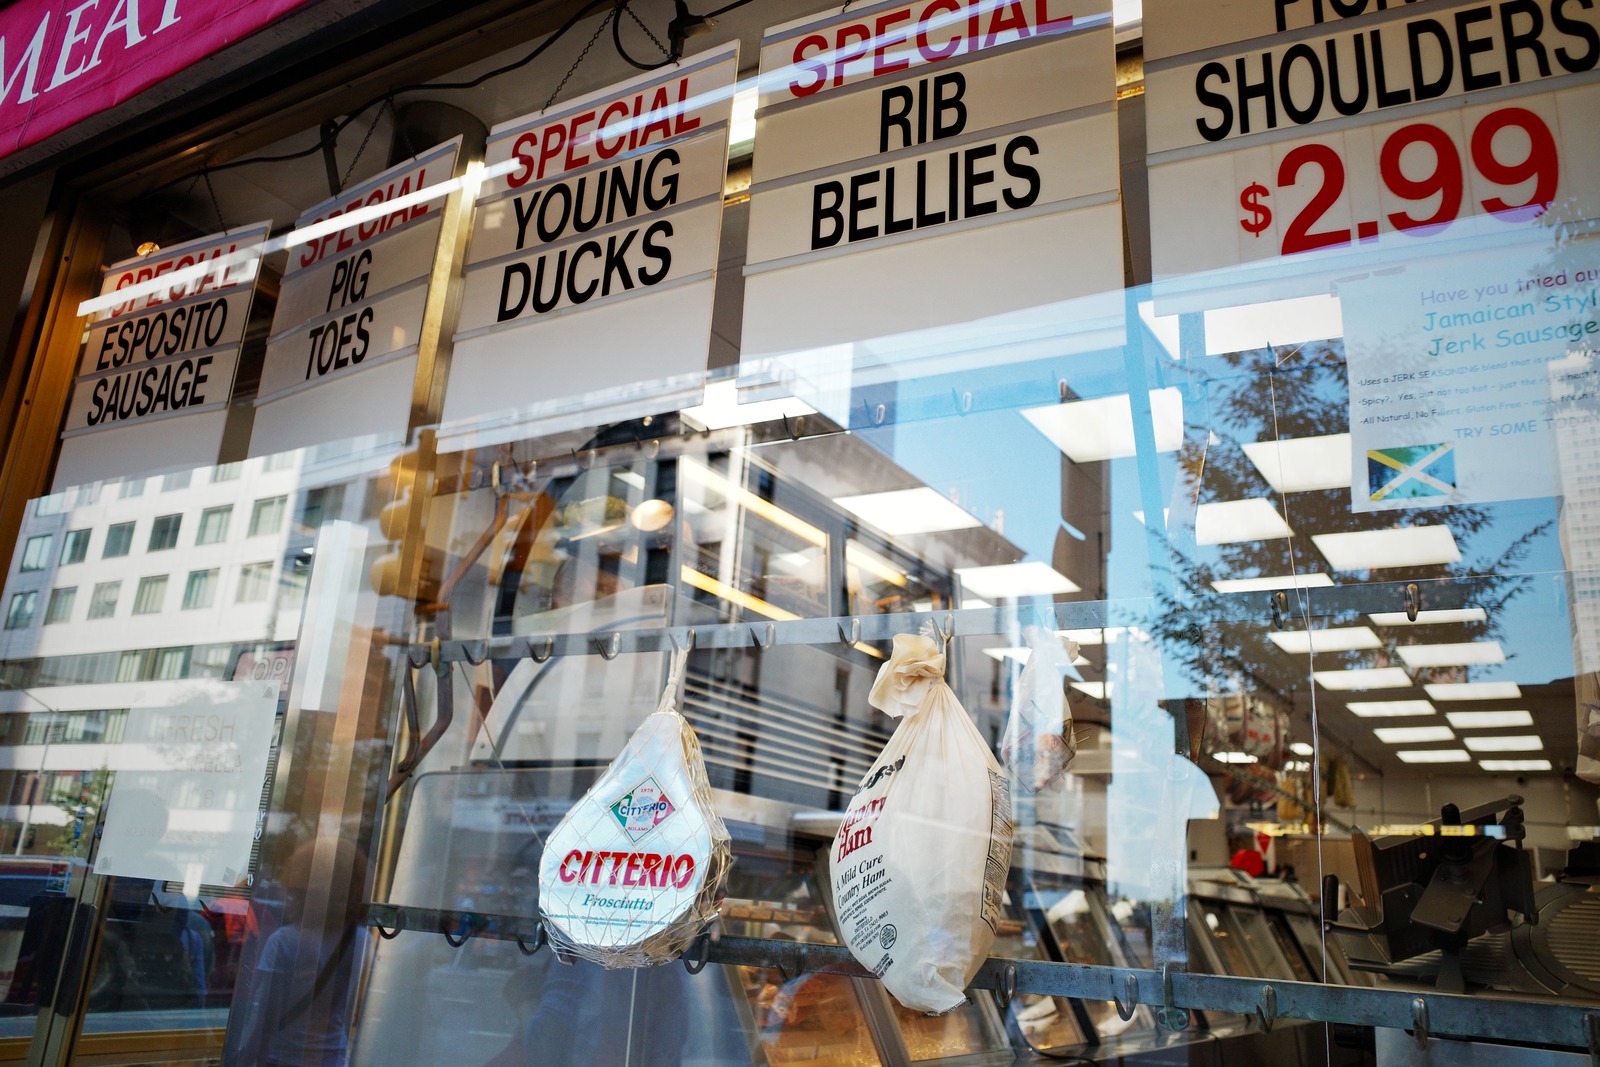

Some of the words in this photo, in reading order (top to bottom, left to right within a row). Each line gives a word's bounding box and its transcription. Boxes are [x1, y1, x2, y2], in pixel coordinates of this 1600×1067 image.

[789, 0, 1074, 98] SPECIAL
[1195, 0, 1600, 142] SHOULDERS
[506, 78, 701, 189] SPECIAL
[880, 71, 967, 154] RIB
[513, 148, 681, 251] YOUNG
[811, 135, 1041, 251] BELLIES
[1240, 107, 1559, 256] $2.99
[301, 169, 429, 268] SPECIAL
[327, 248, 372, 313] PIG
[497, 220, 674, 323] DUCKS
[1420, 290, 1469, 306] Have
[1475, 284, 1509, 302] you
[1516, 269, 1567, 292] tried
[1575, 269, 1600, 283] ou
[96, 298, 228, 372] ESPOSITO
[1423, 300, 1535, 331] Jamaican
[1545, 289, 1600, 314] Styl
[1428, 333, 1486, 357] Jerk
[1496, 321, 1599, 347] Sausage
[306, 307, 374, 381] TOES
[1392, 372, 1416, 383] JERK
[1418, 364, 1480, 379] SEASONING
[87, 355, 213, 427] SAUSAGE
[1415, 410, 1429, 419] No
[1453, 426, 1484, 439] TRY
[1489, 419, 1538, 436] SOME
[620, 801, 667, 817] CITTERIO
[559, 849, 696, 890] CITTERIO
[837, 825, 873, 864] Ham
[841, 865, 857, 888] Mild
[859, 854, 884, 874] Cure
[582, 893, 654, 912] Prosciutto
[838, 883, 860, 909] Country
[862, 868, 886, 890] Ham
